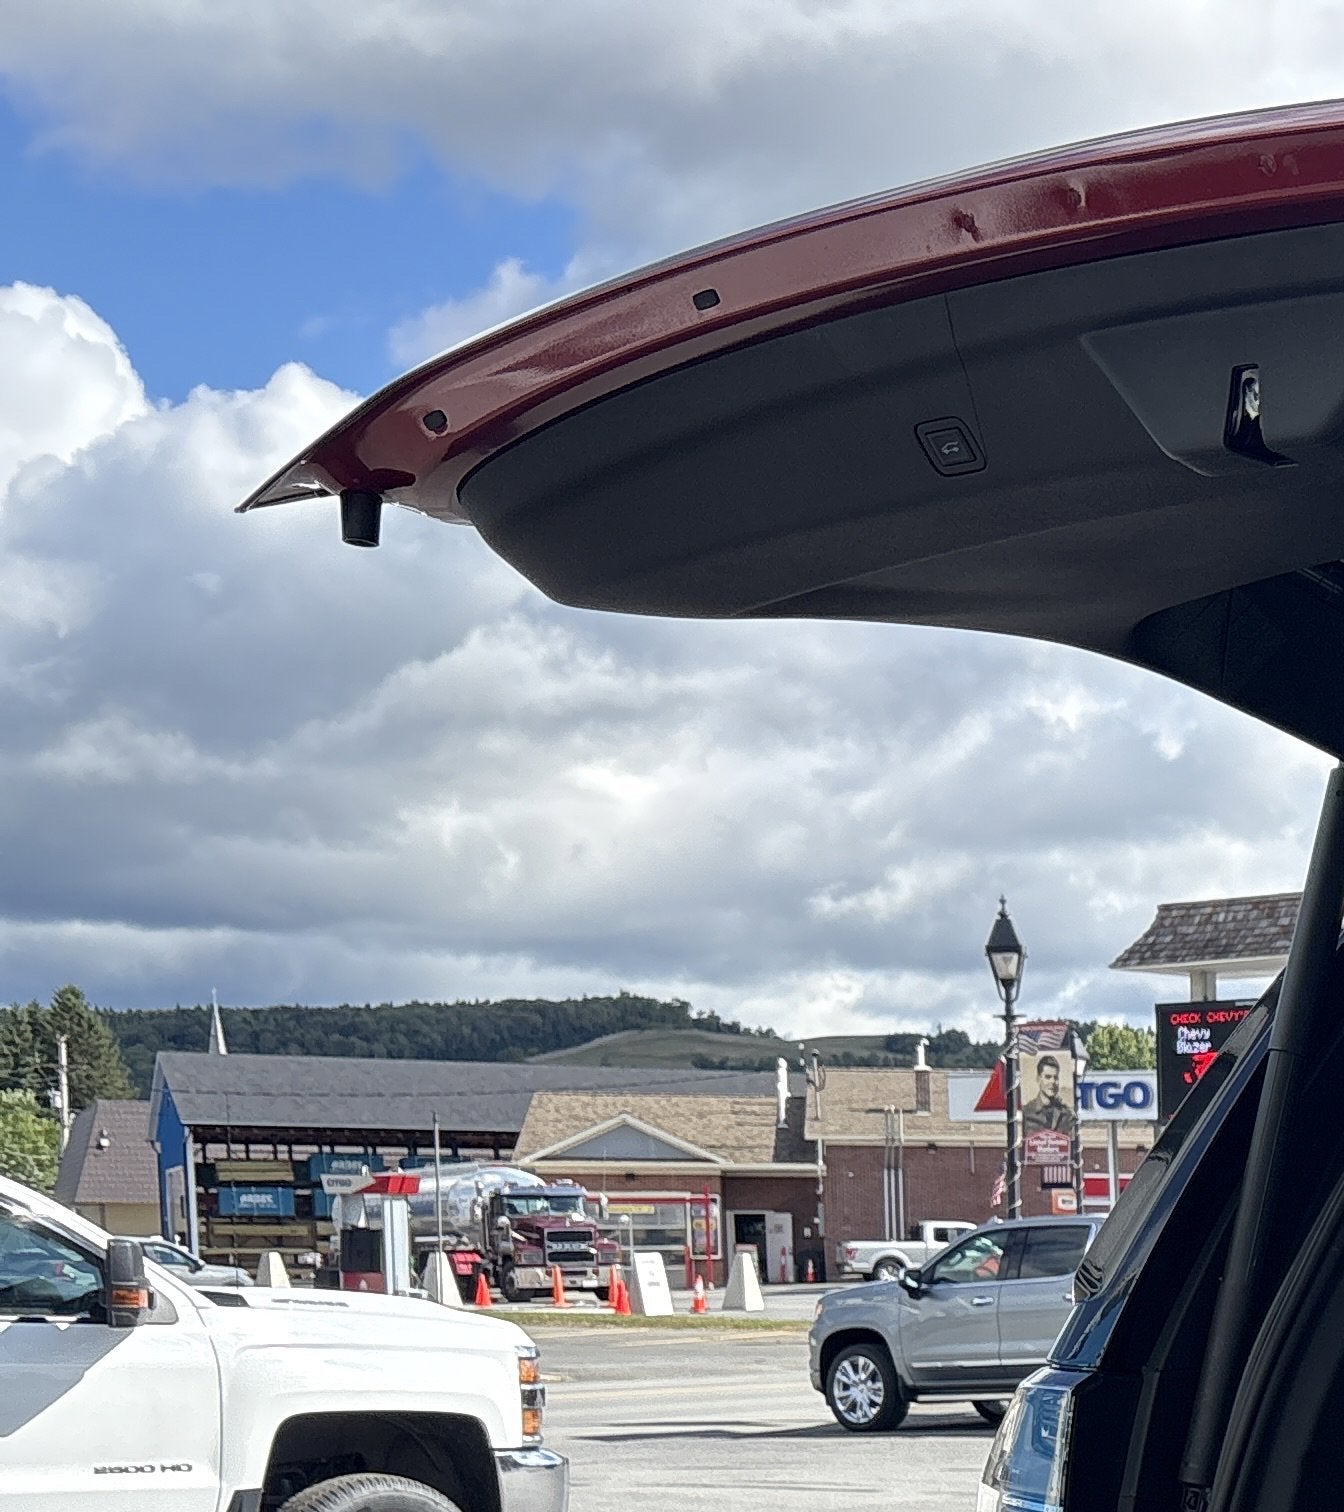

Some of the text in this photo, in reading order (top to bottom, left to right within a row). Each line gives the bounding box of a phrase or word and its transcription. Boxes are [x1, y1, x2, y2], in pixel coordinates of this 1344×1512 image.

[1170, 1013, 1202, 1026] CHECK
[1177, 1026, 1211, 1041] Chevy
[1176, 1040, 1212, 1054] Blazer
[1077, 1081, 1151, 1111] TGO
[160, 1463, 193, 1473] HD
